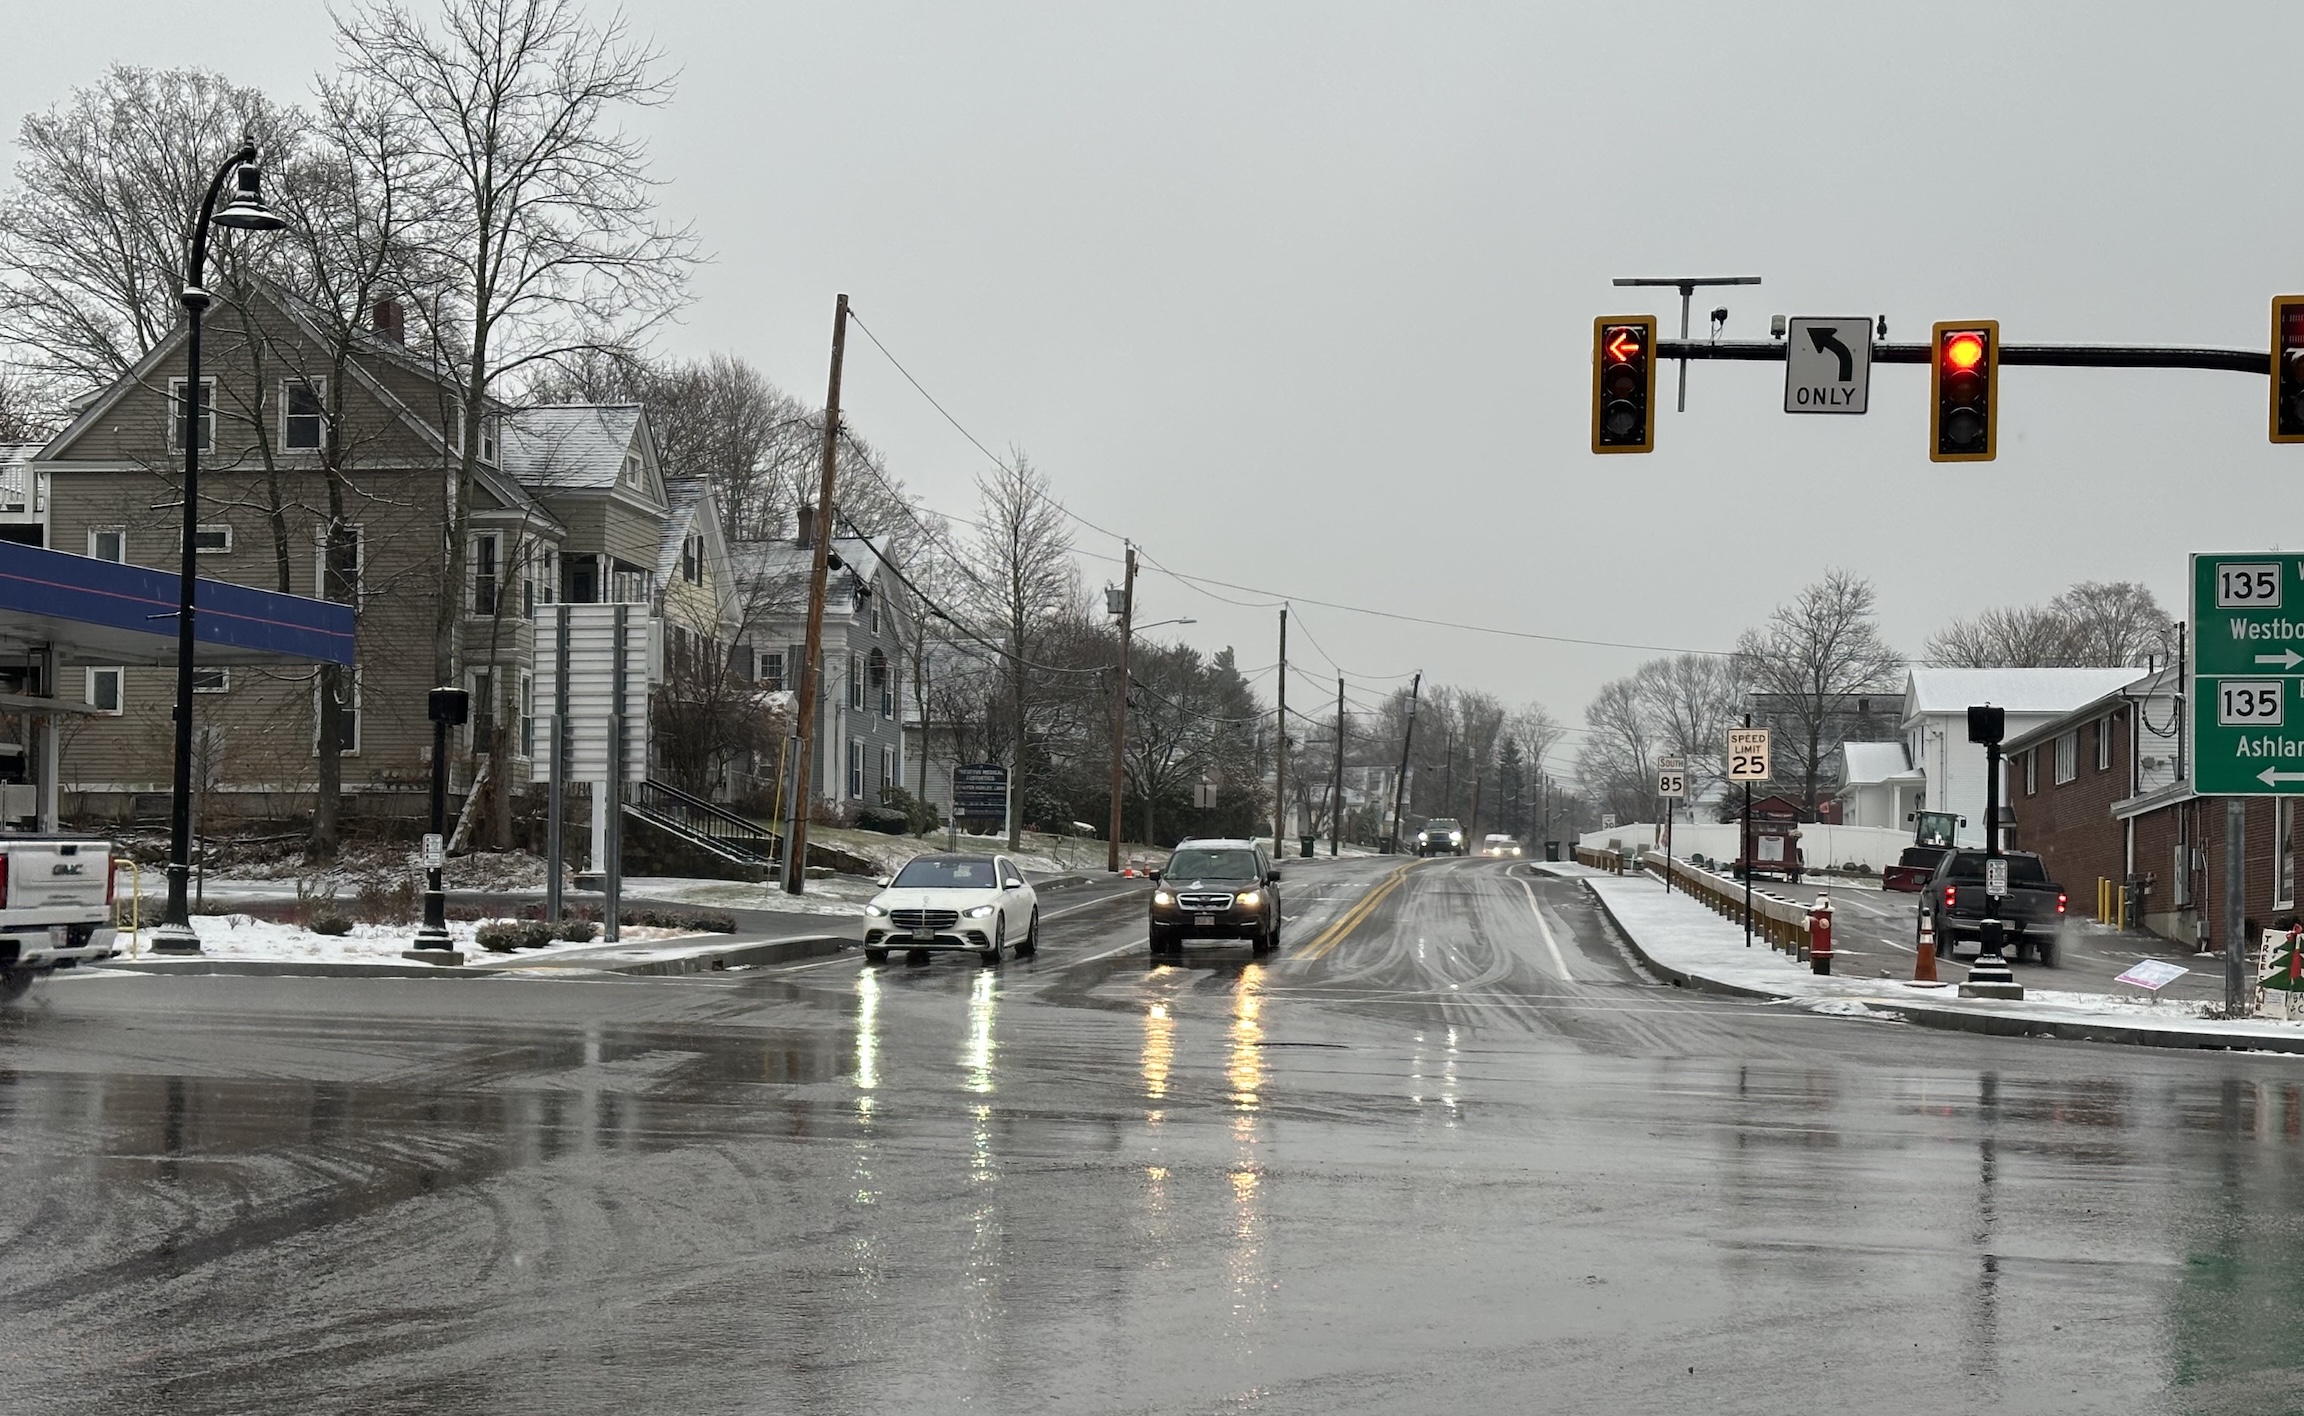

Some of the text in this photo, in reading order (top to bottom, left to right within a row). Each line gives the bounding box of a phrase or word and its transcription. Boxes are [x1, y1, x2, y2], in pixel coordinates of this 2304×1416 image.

[1797, 387, 1856, 405] ONLY
[2221, 571, 2276, 600] 135
[2230, 617, 2304, 640] Westbo
[2224, 689, 2278, 717] 135
[1731, 734, 1766, 743] SPEED
[1735, 745, 1761, 754] LIMIT
[1660, 758, 1684, 767] SOUTH
[1732, 756, 1765, 774] 25
[1660, 776, 1682, 791] 85
[52, 864, 84, 876] GMC
[2259, 935, 2272, 971] TREE
